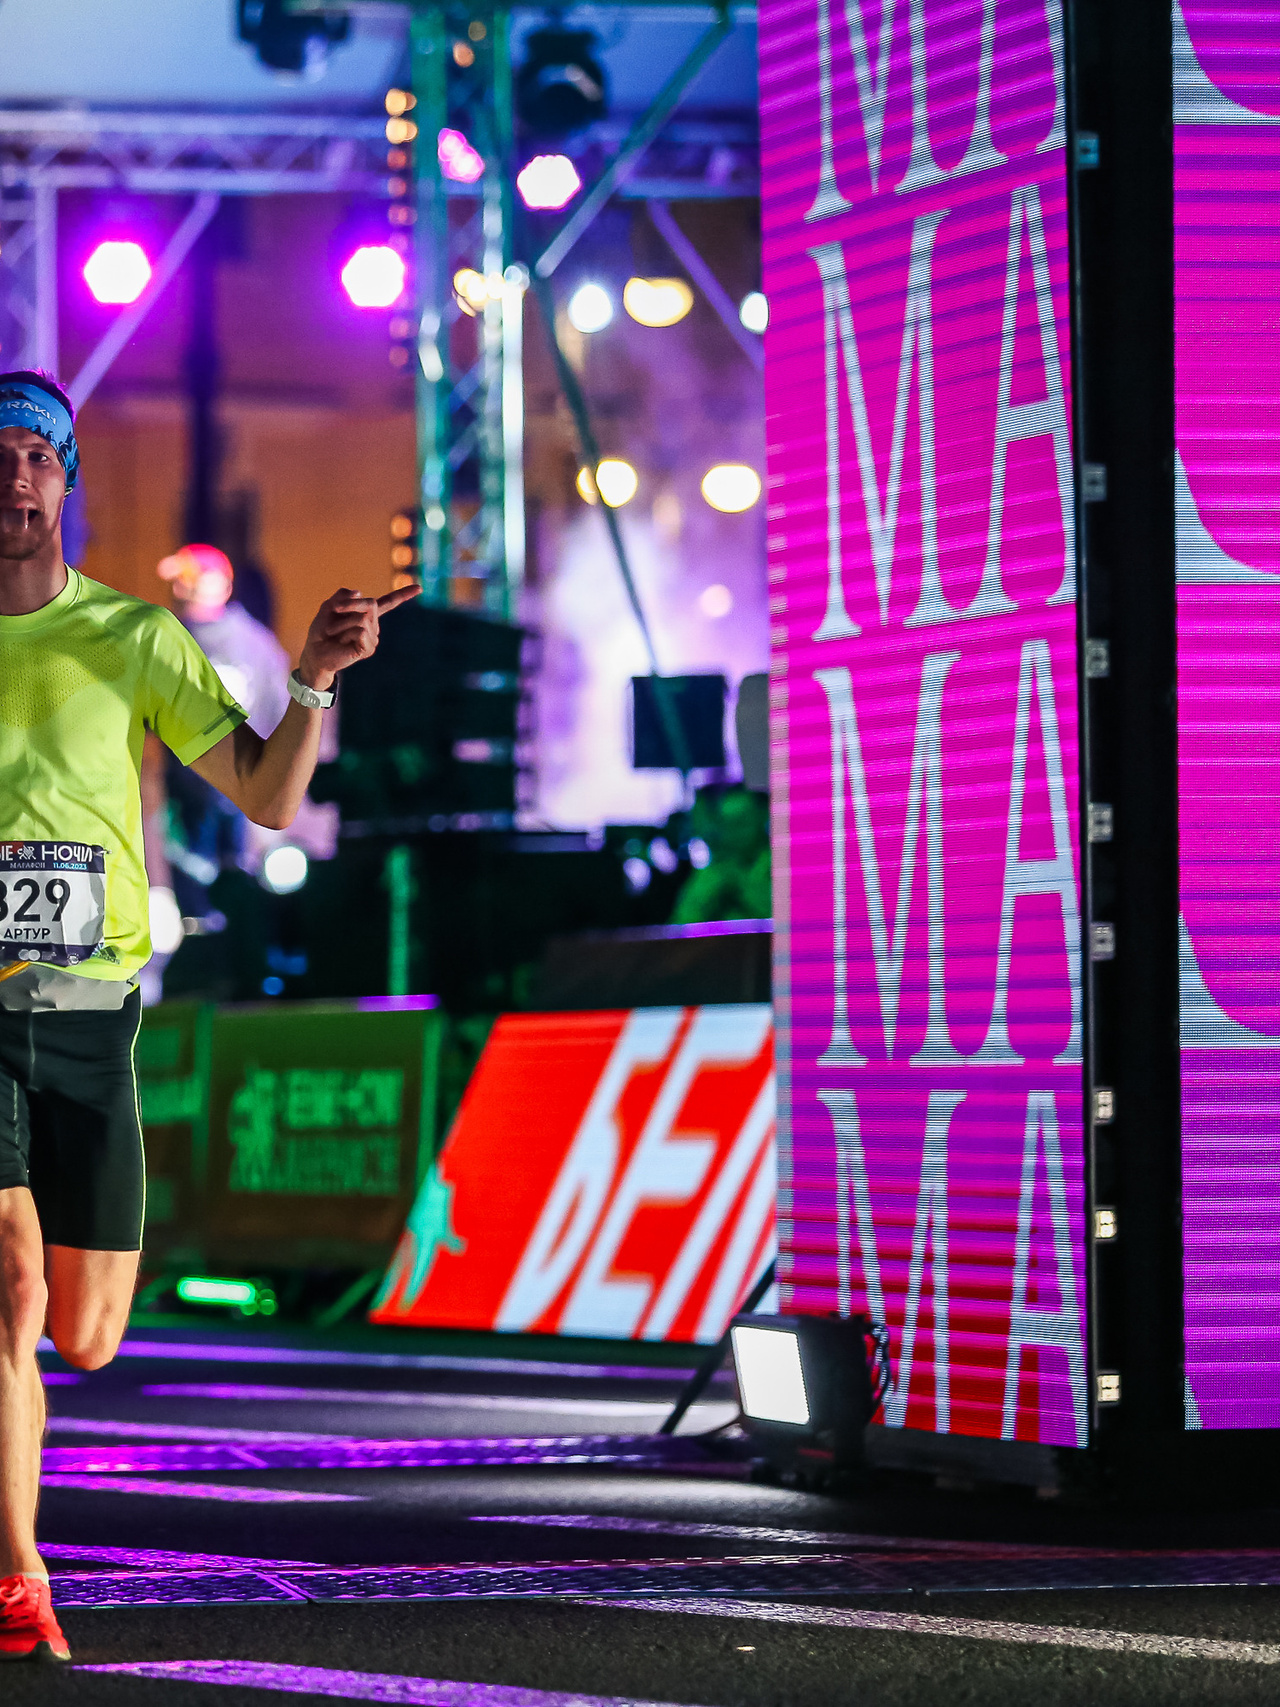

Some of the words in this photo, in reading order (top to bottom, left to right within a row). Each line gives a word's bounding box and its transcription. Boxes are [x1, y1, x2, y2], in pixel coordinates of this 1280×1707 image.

[42, 845, 93, 862] НОЧИ
[3, 928, 51, 940] АРТУР
[494, 1003, 778, 1345] БЕЛ
